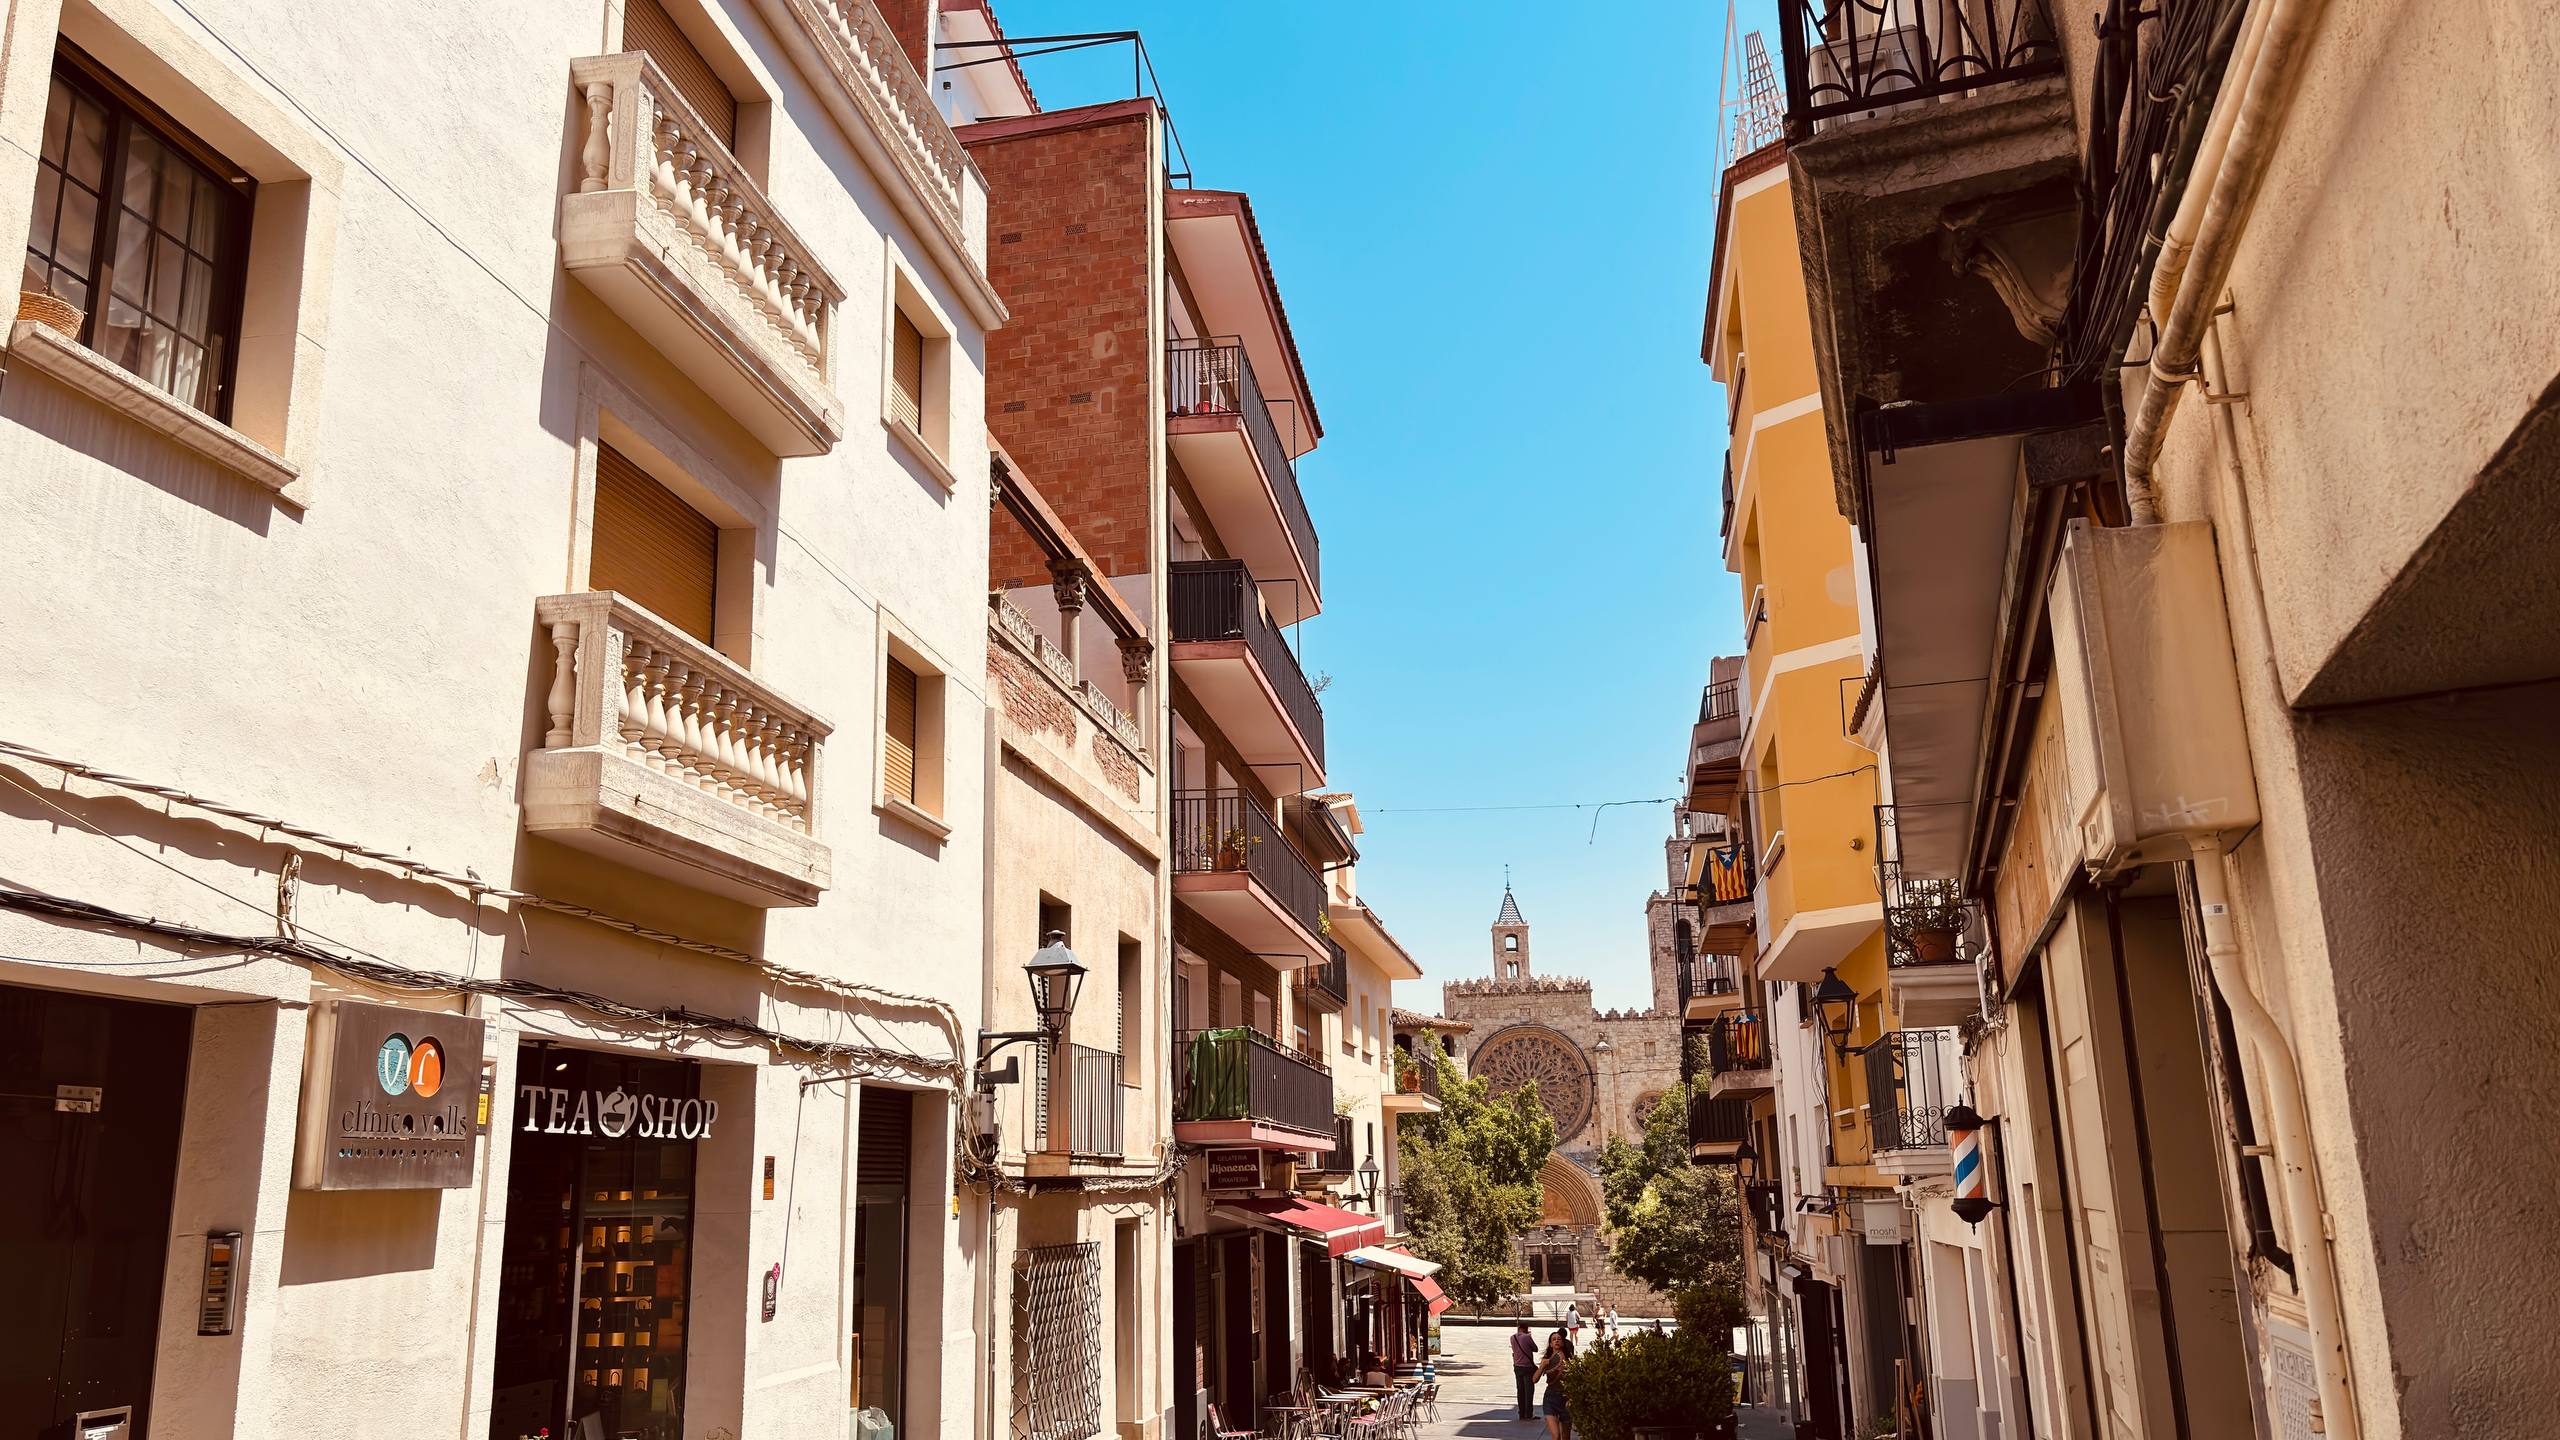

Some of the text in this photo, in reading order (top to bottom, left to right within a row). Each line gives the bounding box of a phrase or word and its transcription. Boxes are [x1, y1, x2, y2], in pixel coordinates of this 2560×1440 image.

[342, 1100, 415, 1134] clínica
[422, 1105, 467, 1136] valls
[521, 1084, 593, 1135] TEA
[638, 1093, 719, 1140] SHOP
[1210, 1164, 1258, 1174] Jijonenca
